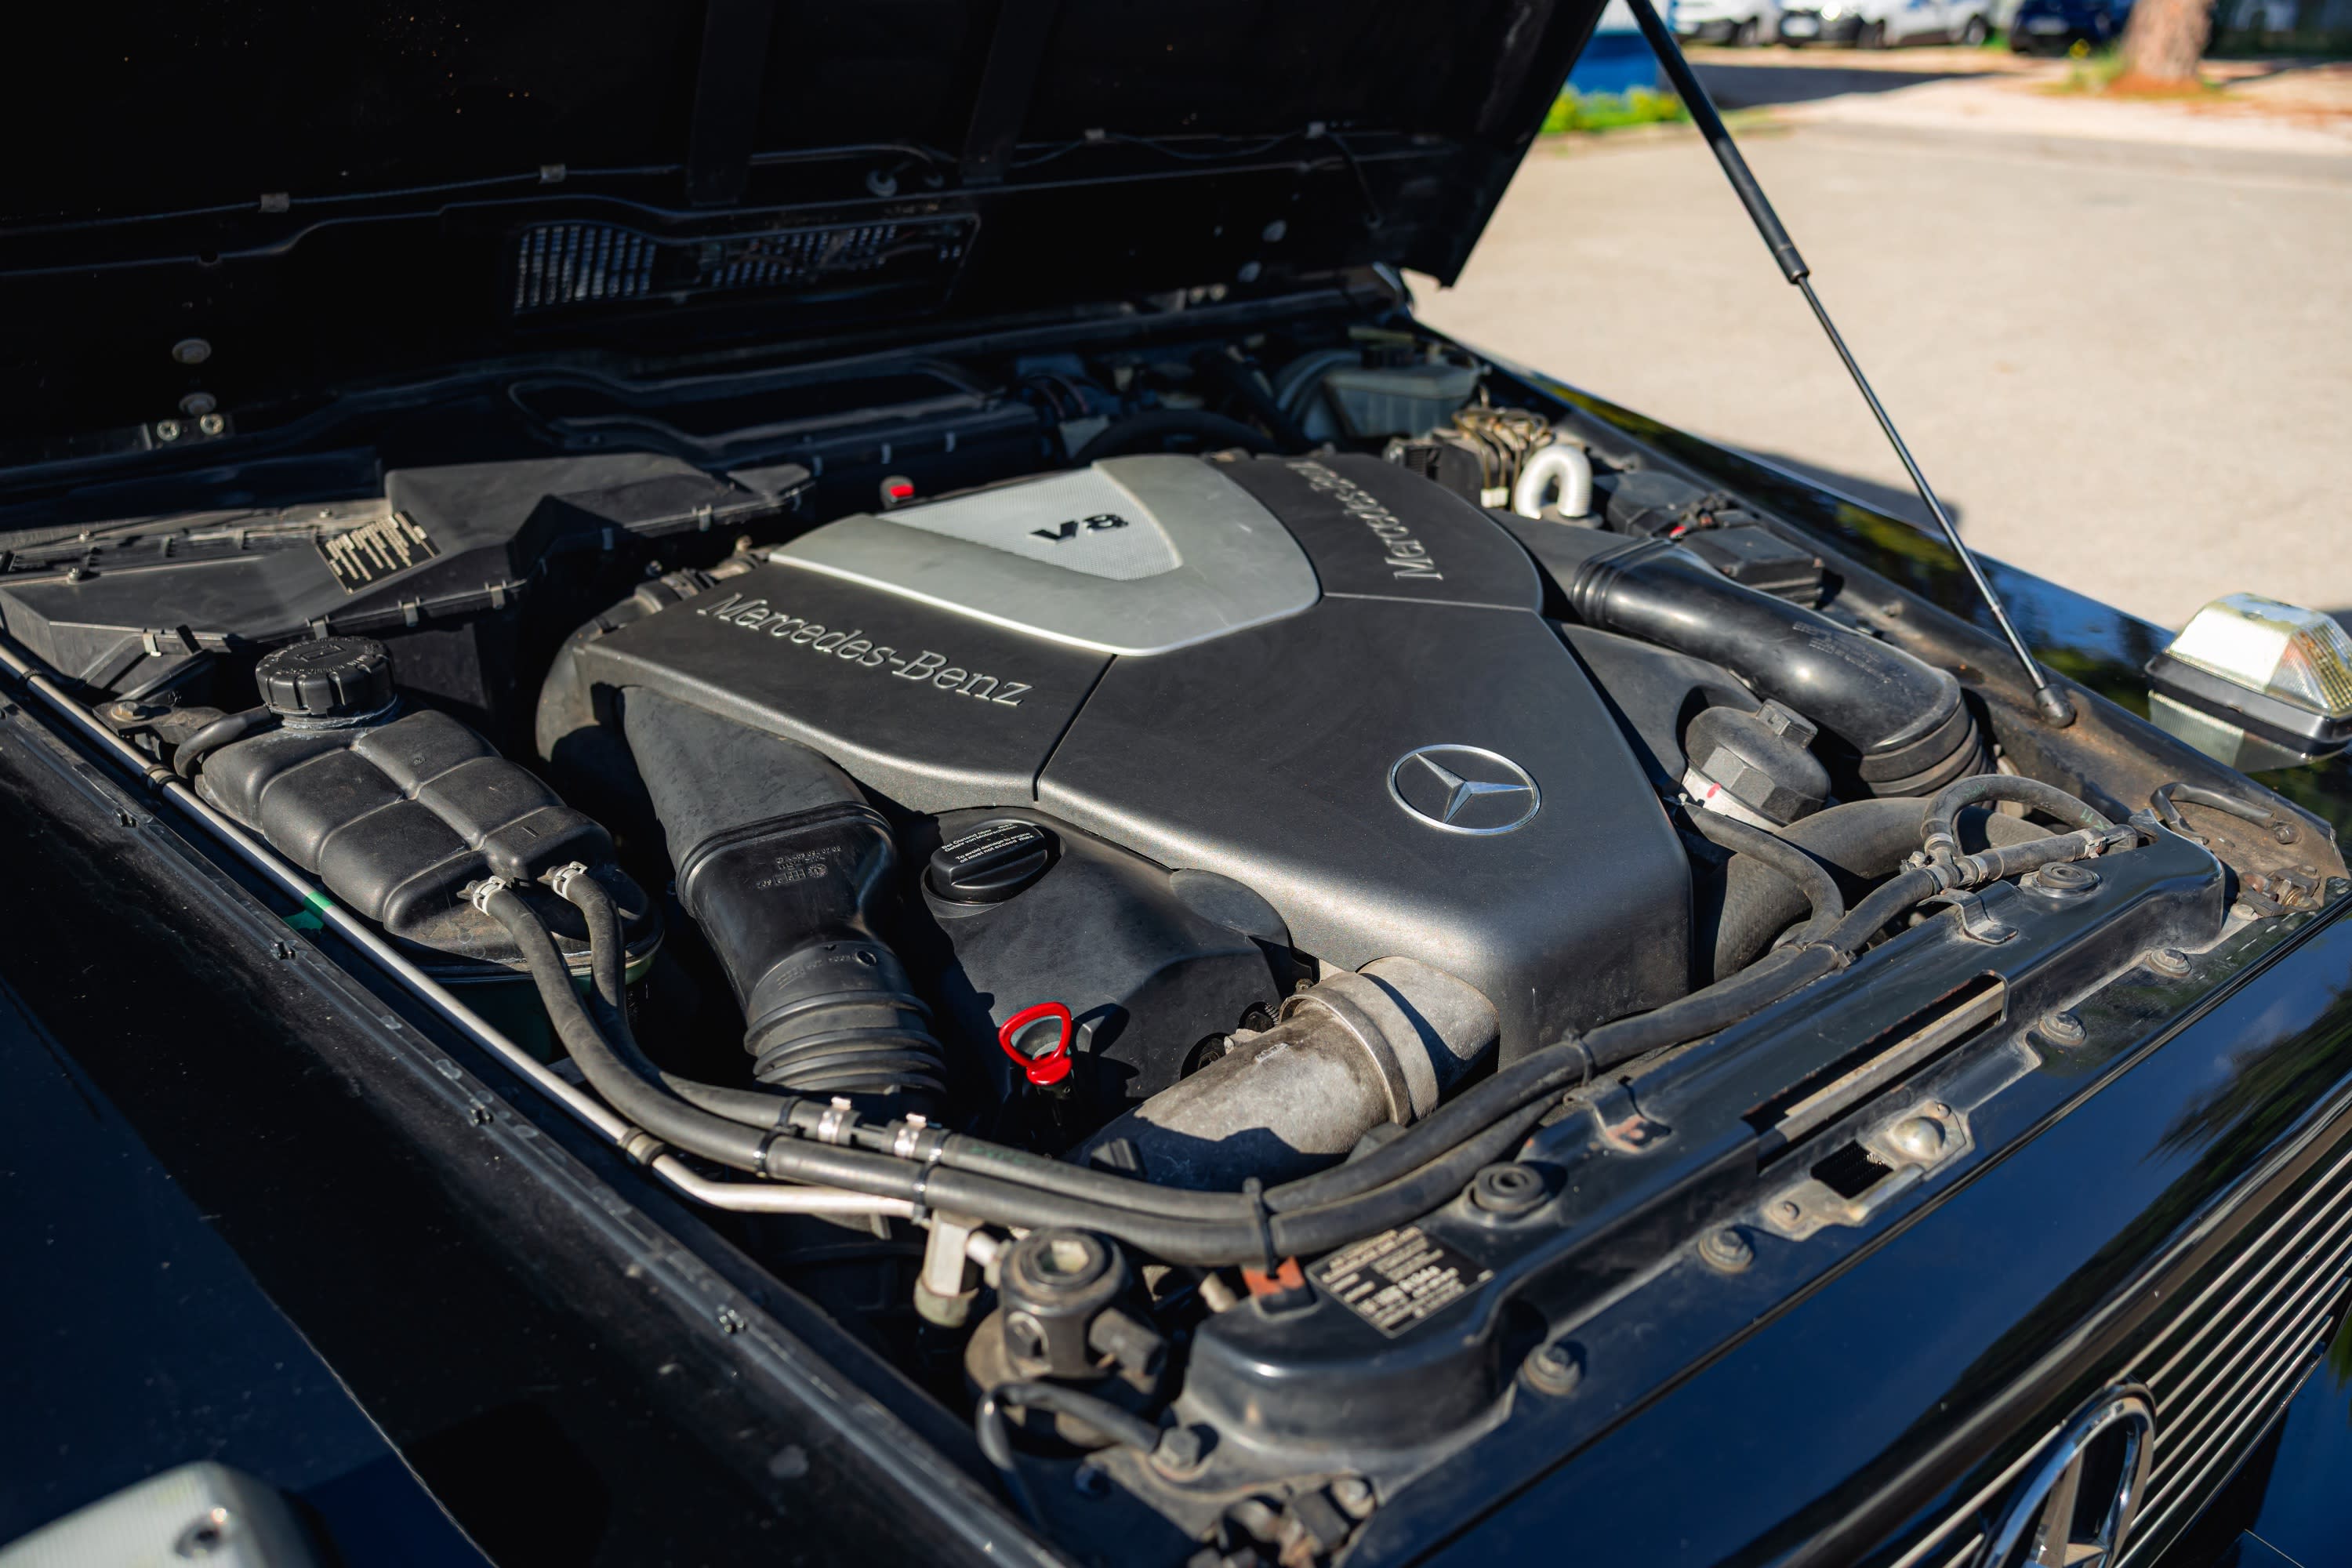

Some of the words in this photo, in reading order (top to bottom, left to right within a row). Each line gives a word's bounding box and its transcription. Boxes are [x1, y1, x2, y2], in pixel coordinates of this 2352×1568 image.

[1028, 513, 1129, 545] V8
[696, 593, 1035, 707] Mercedes-Benz
[965, 848, 981, 856] avoid
[981, 840, 1004, 850] damage
[994, 840, 1018, 849] exceed
